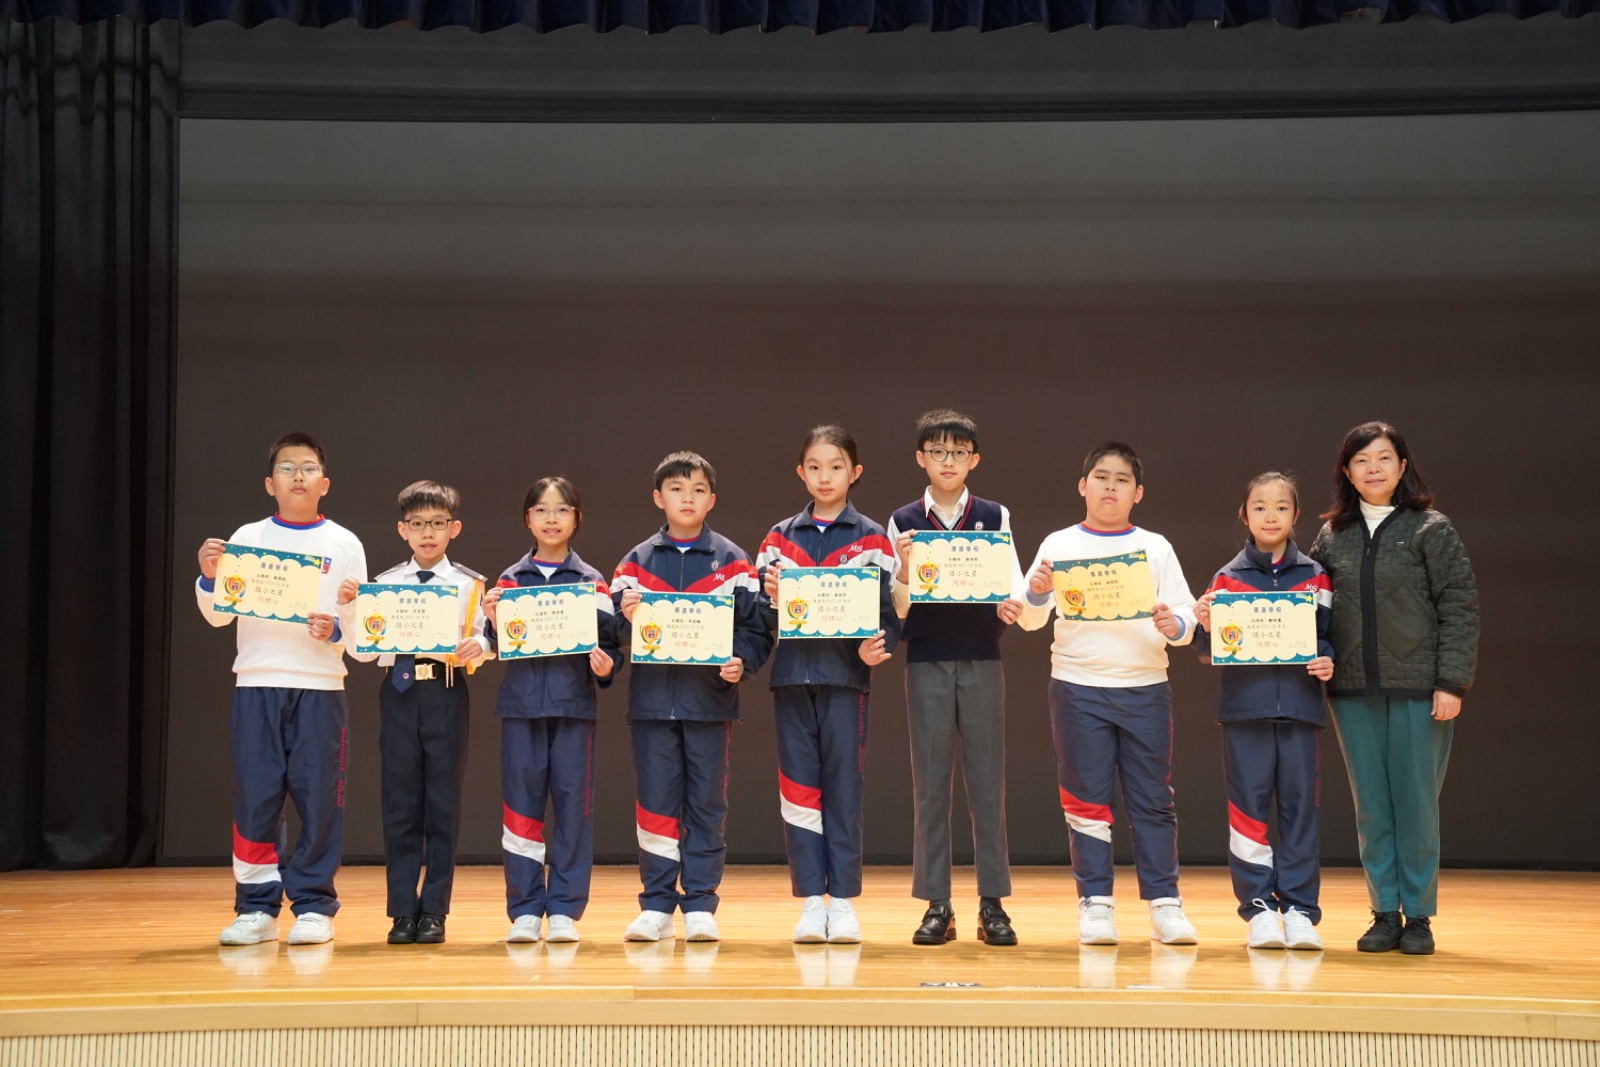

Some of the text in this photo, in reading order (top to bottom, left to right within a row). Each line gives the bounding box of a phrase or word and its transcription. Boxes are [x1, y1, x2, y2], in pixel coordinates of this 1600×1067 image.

[848, 544, 863, 552] MS
[713, 573, 725, 581] MS
[1304, 583, 1318, 593] MS
